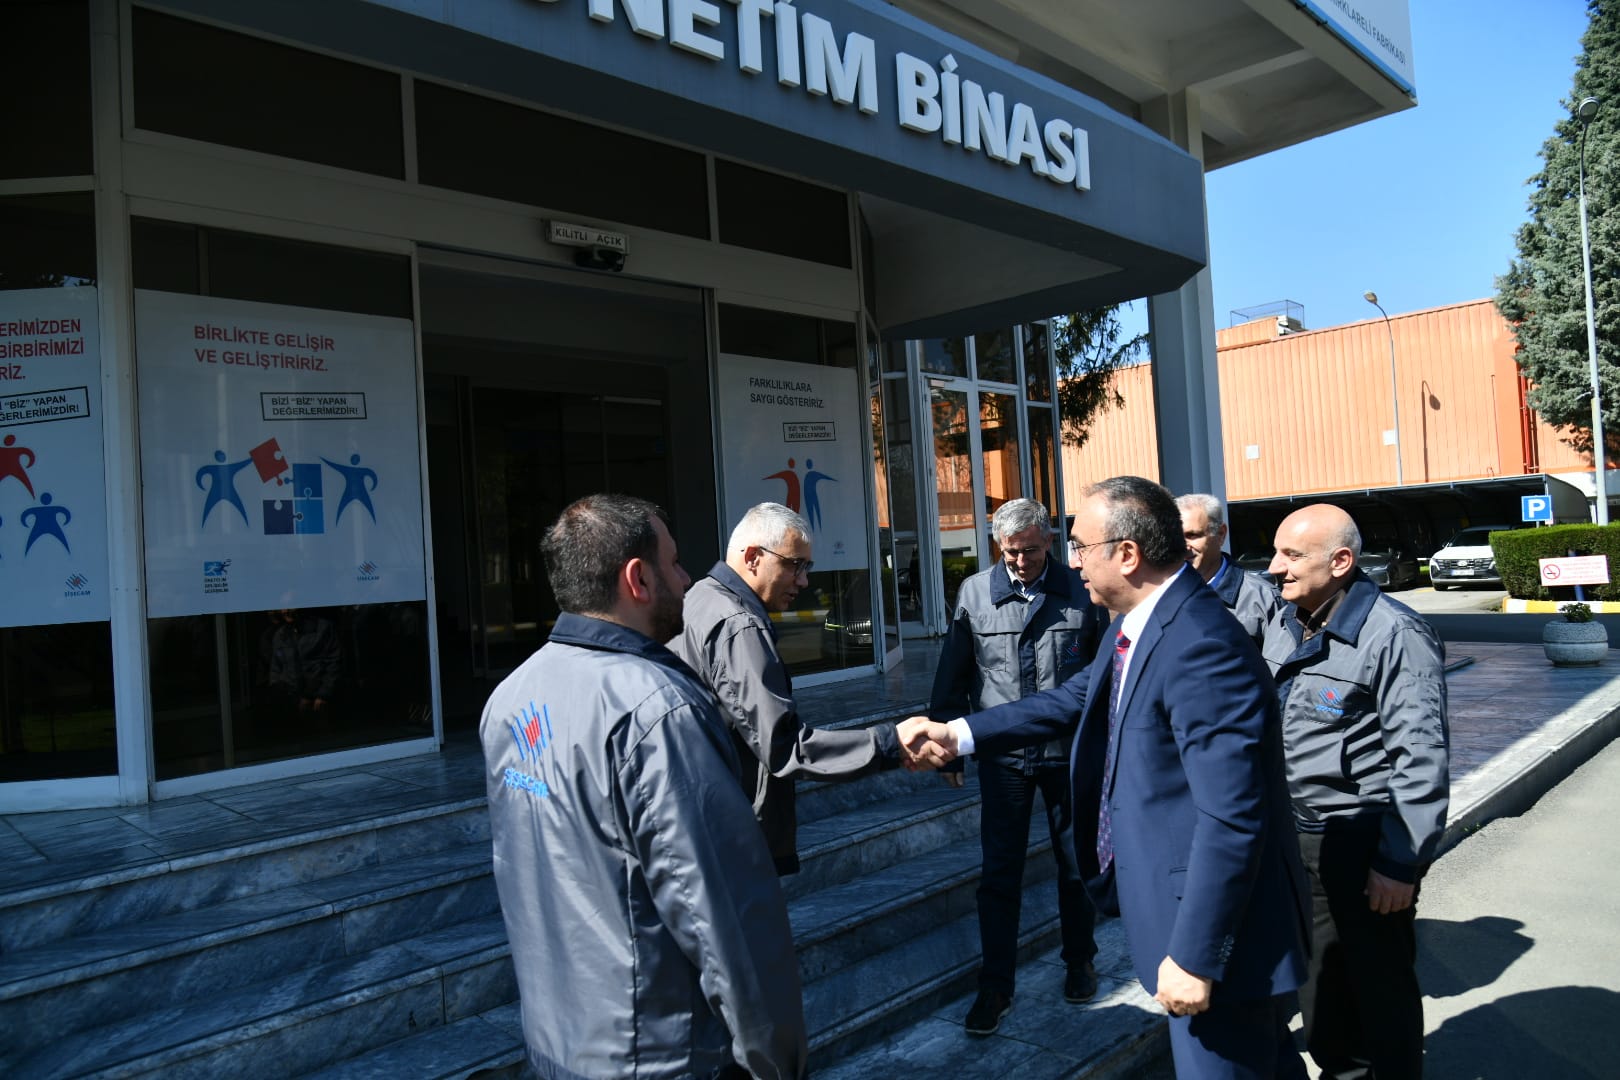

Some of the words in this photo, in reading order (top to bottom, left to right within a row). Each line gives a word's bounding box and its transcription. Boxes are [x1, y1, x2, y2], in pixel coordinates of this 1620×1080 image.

[896, 52, 1091, 191] BİNASI
[0, 317, 81, 337] ERİMİZDEN
[194, 323, 270, 345] BİRLİKTE
[274, 333, 335, 353] GELİŞİR
[194, 348, 217, 364] VE
[222, 350, 329, 372] GELİŞTİRİRİZ.
[749, 377, 813, 393] FARKLILIKLARA
[33, 395, 66, 406] YAPAN
[317, 397, 347, 405] YAPAN
[750, 392, 775, 405] SAYGI
[1528, 499, 1546, 518] P
